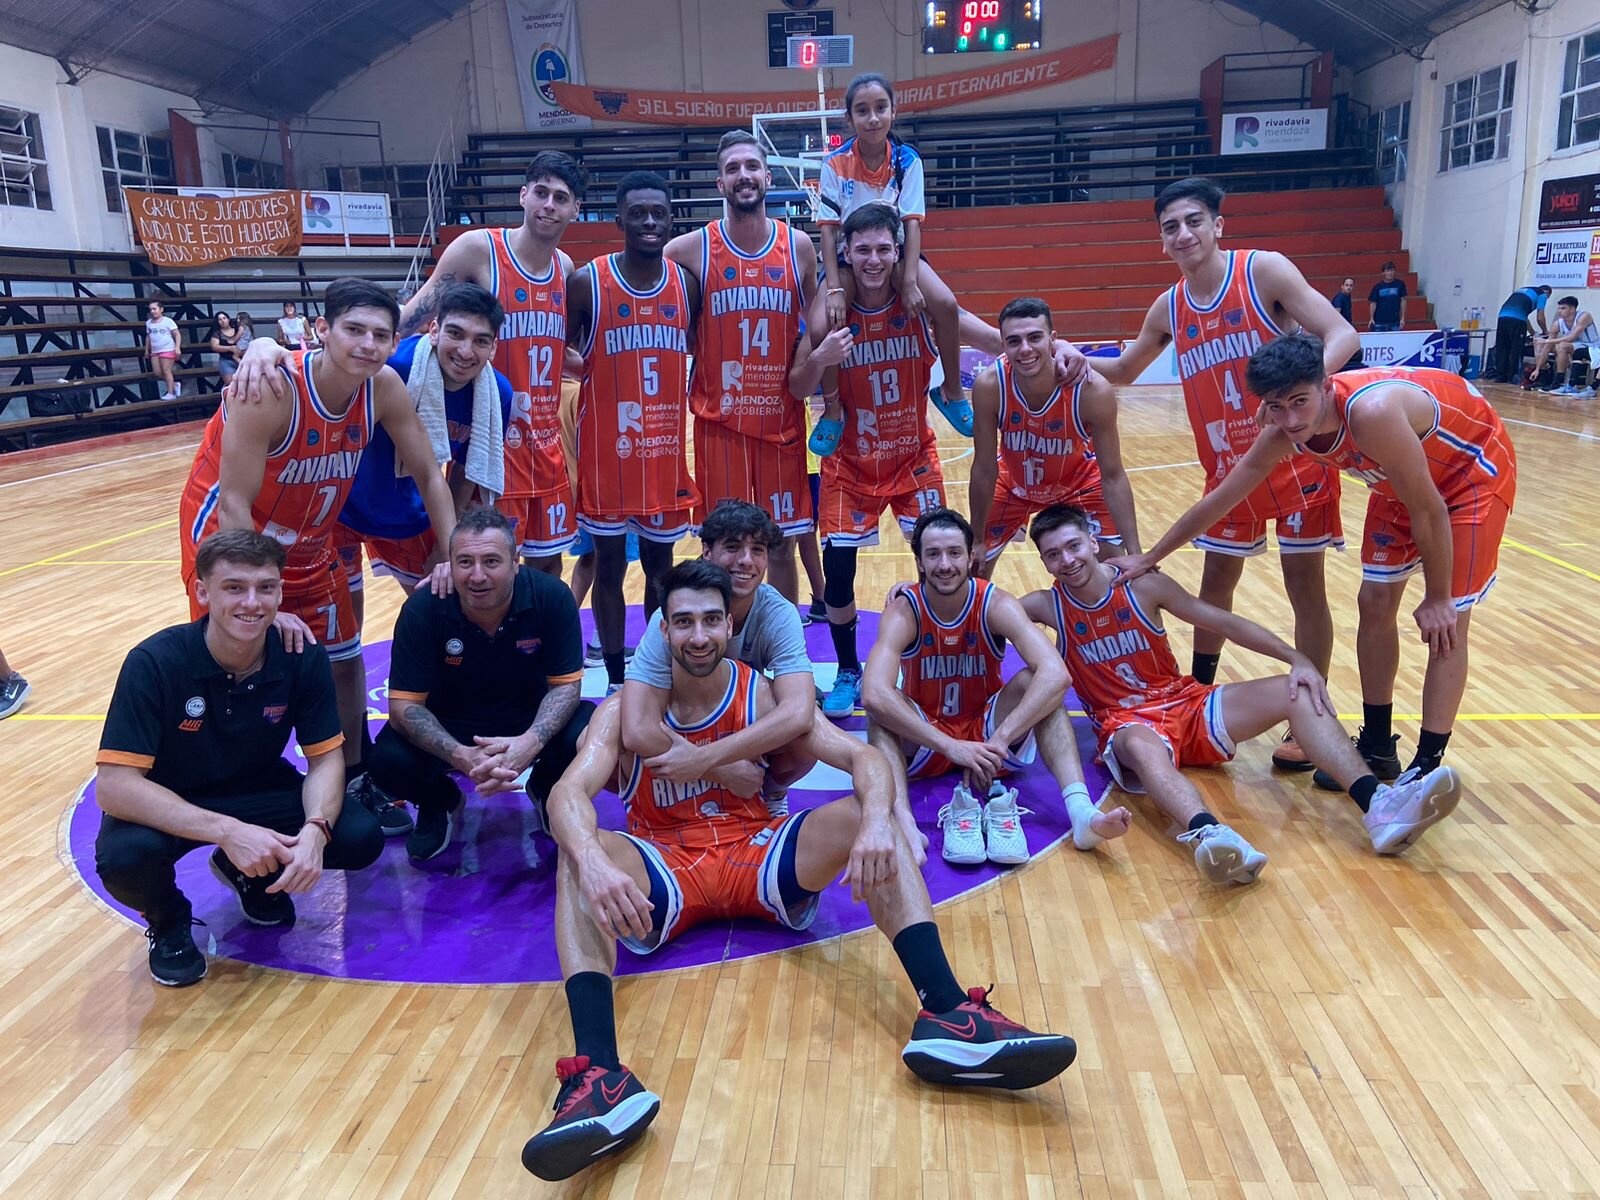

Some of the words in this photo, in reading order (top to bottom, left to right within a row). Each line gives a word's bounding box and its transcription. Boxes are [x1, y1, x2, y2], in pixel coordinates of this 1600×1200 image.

[534, 20, 562, 30] Deportes
[802, 41, 815, 65] 0
[638, 99, 651, 115] SI
[653, 100, 673, 116] EL
[676, 100, 723, 117] SUEÑO
[726, 102, 773, 118] FUERA
[936, 60, 1061, 99] ETERNAMENTE
[1264, 126, 1310, 137] mendoza
[1265, 116, 1310, 127] rivadavia
[142, 197, 208, 221] GRACIAS
[348, 202, 383, 210] rivadavia
[140, 216, 174, 242] NADA
[177, 223, 197, 244] DE
[201, 224, 234, 245] ESTO
[238, 218, 291, 244] HUBIERA
[1552, 252, 1586, 264] LLAVER
[711, 286, 792, 317] RIVADAVIA
[605, 323, 688, 355] RIVADAVIA
[738, 317, 770, 357] 14
[528, 345, 553, 386] 12
[745, 363, 786, 372] rivadavia
[1179, 329, 1263, 380] RIVADAVIA
[642, 356, 659, 396] 5
[744, 372, 785, 381] mendoza
[868, 368, 900, 407] 13
[1224, 369, 1242, 411] 4
[733, 406, 785, 416] GOBIERNO
[311, 485, 337, 527] 7
[769, 490, 795, 521] 14
[914, 488, 941, 514] 13
[546, 502, 568, 536] 12
[1286, 511, 1303, 534] 4
[316, 603, 337, 640] 7
[944, 635, 959, 645] MIG
[942, 682, 960, 717] 9
[179, 719, 203, 732] MIG
